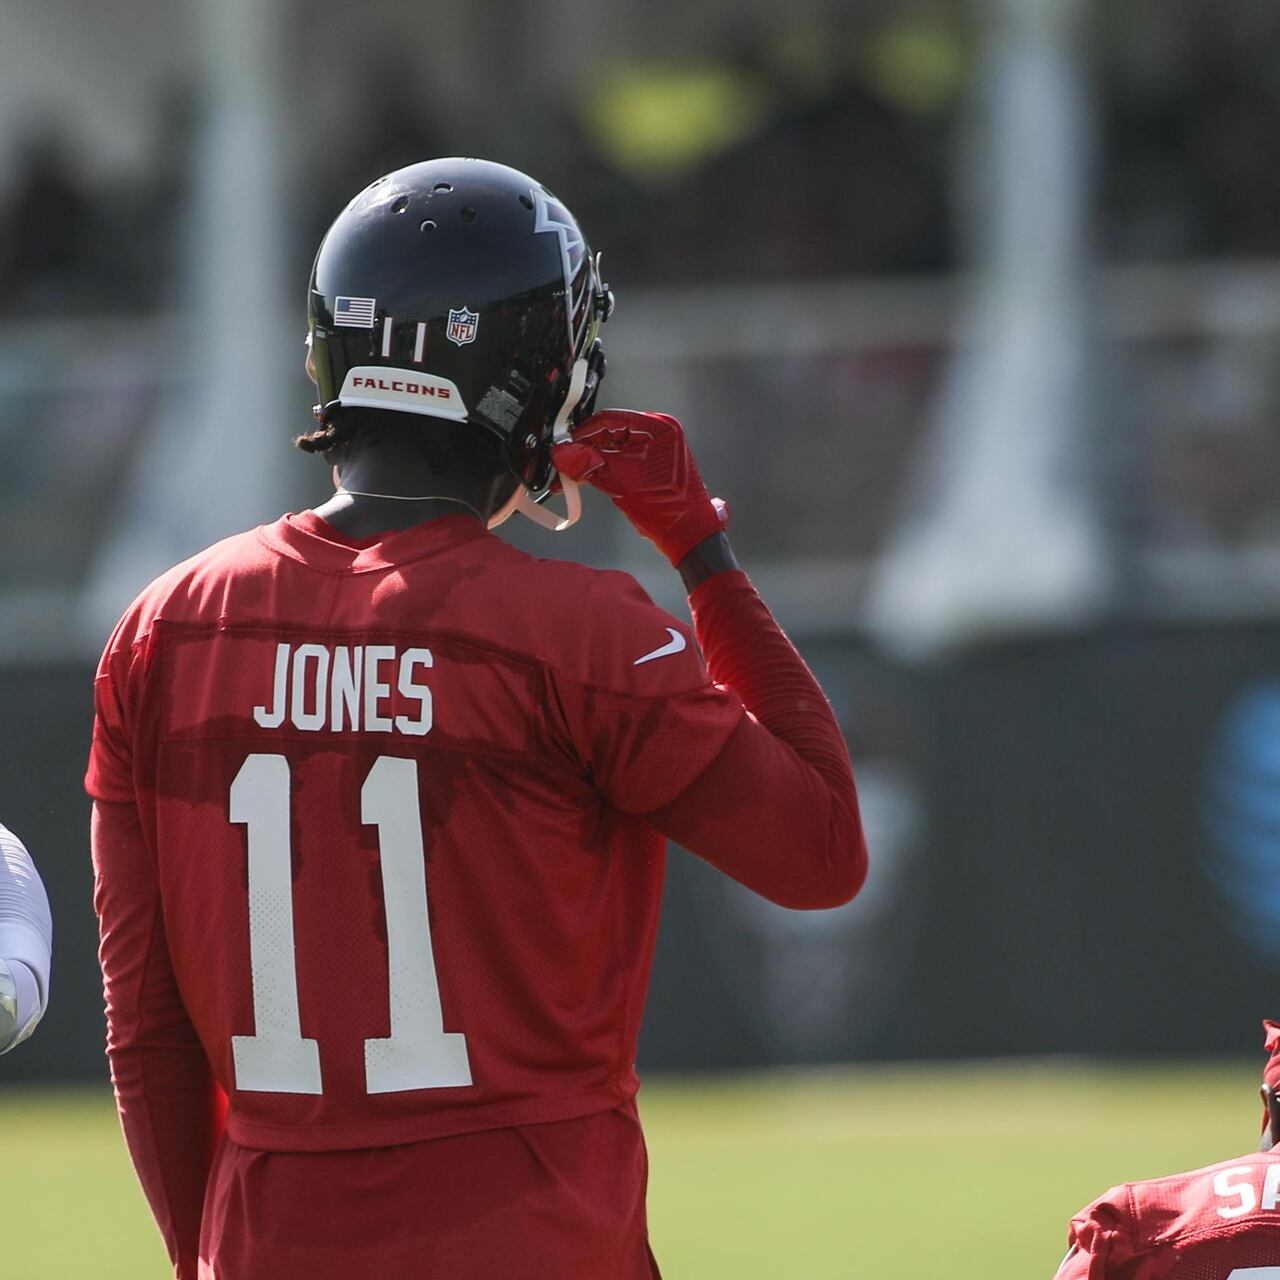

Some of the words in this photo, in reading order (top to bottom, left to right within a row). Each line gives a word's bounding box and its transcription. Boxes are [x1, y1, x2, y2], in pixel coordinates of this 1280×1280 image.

[352, 376, 451, 399] FALCONS
[253, 643, 434, 736] JONES
[229, 753, 473, 1095] 11
